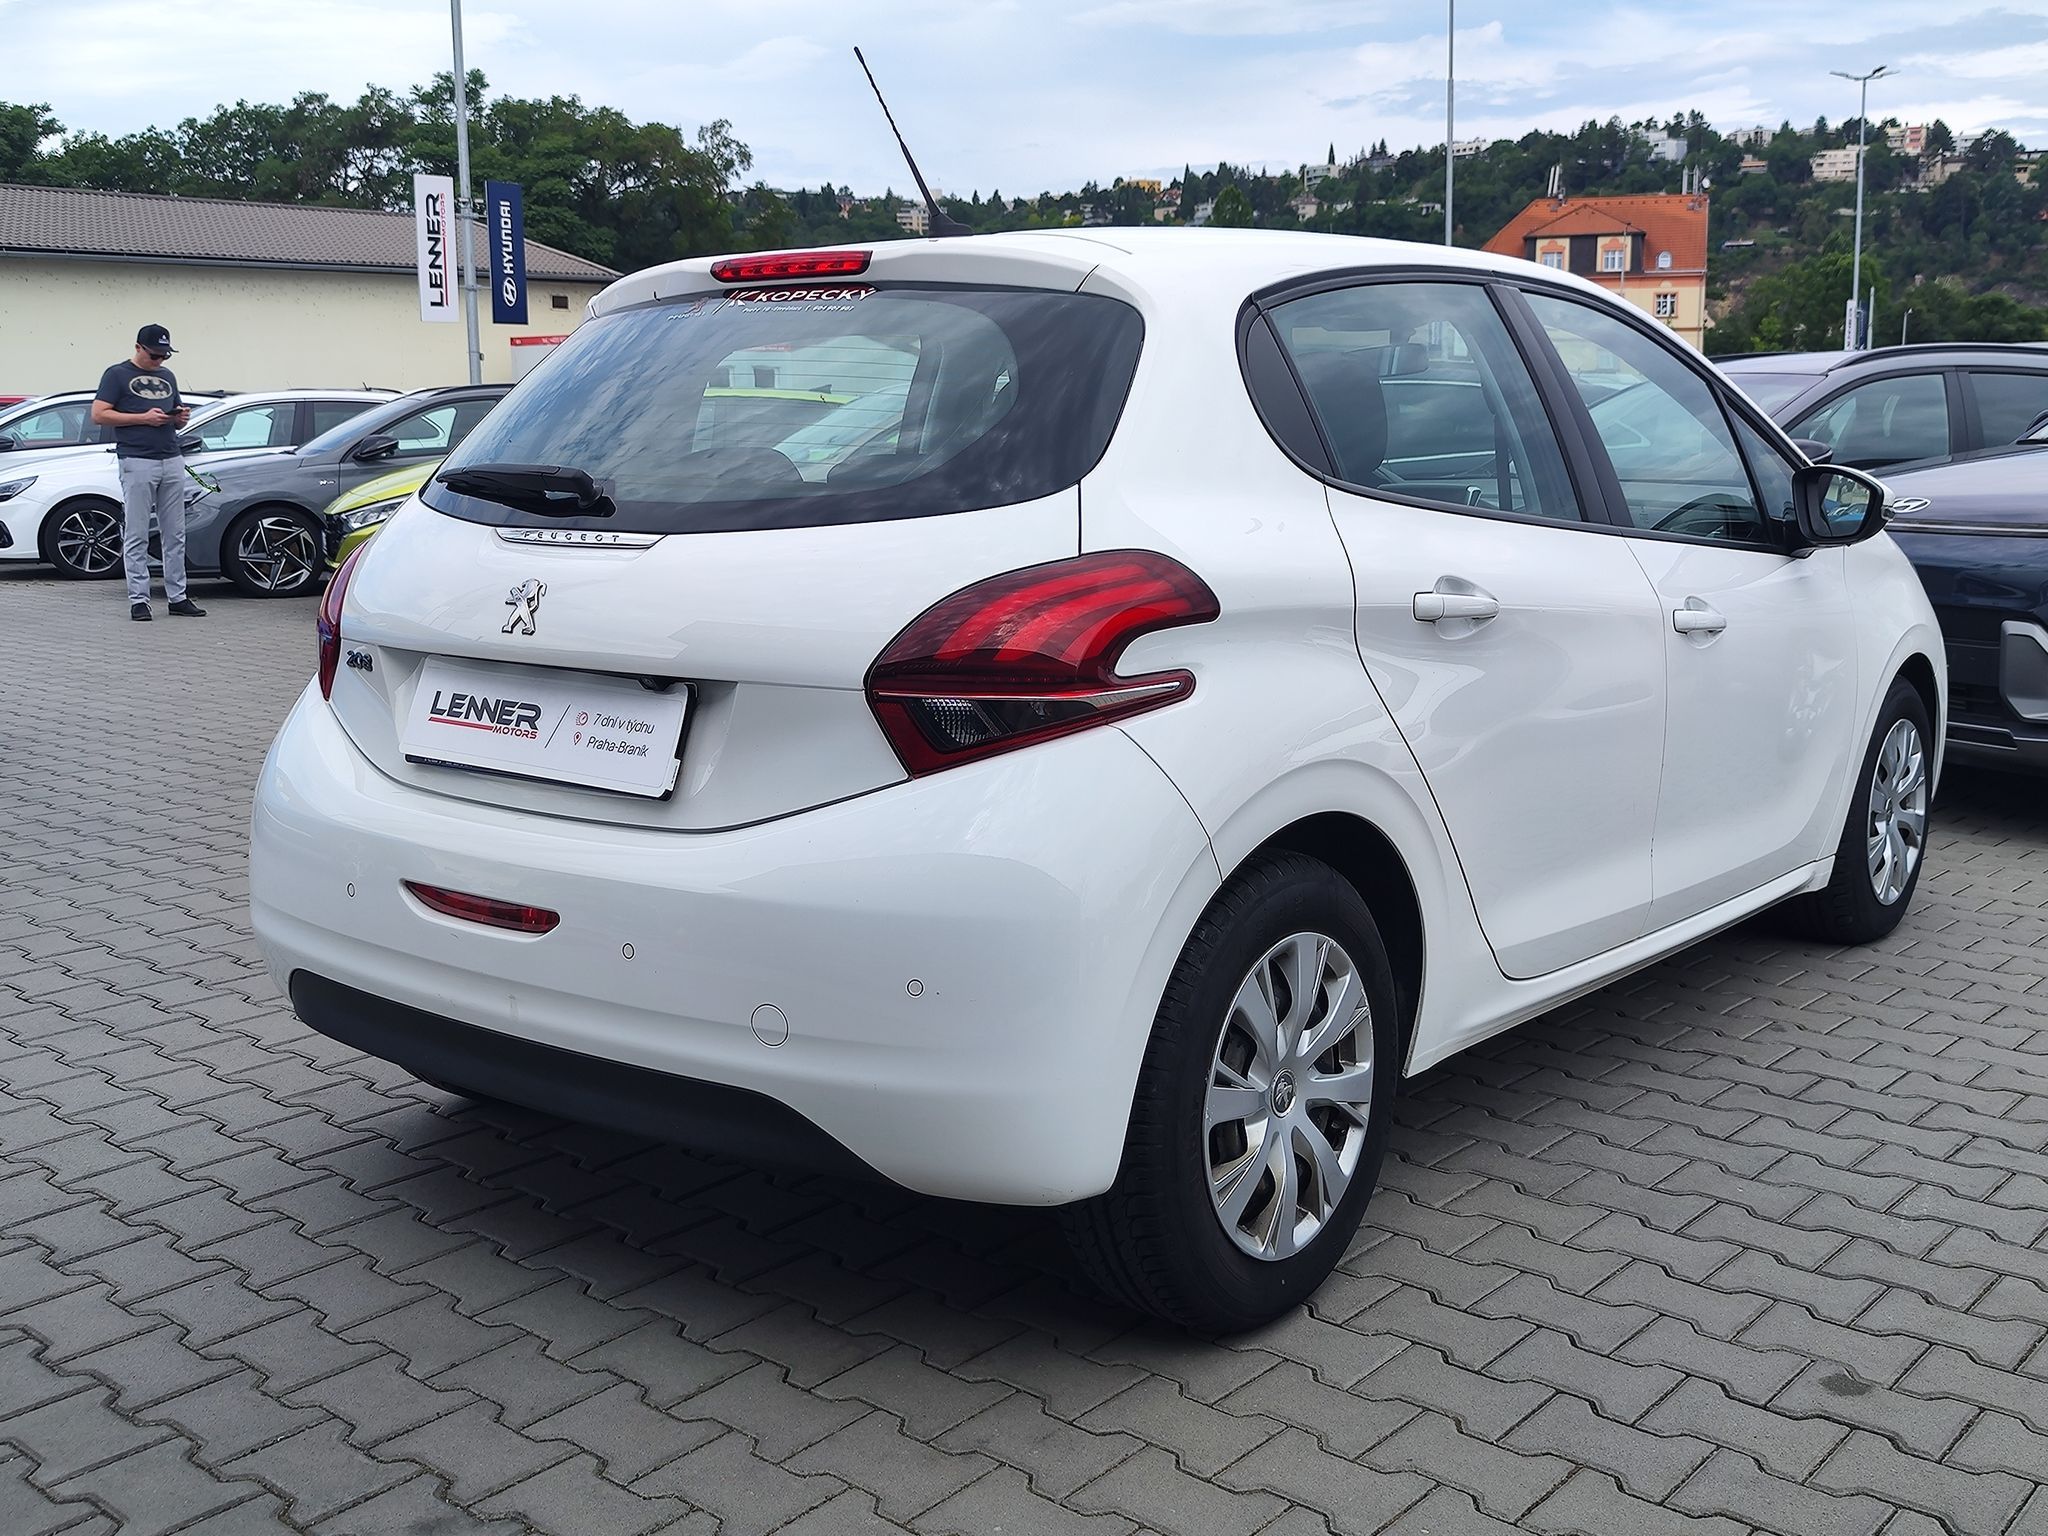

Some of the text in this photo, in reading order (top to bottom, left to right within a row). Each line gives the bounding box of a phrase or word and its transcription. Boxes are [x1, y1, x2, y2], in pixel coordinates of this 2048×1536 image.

[500, 200, 515, 275] HYUNDAI
[425, 193, 445, 308] LENNER
[523, 531, 620, 543] PEUGEOT
[345, 650, 374, 672] 208
[429, 690, 542, 731] LENNER
[492, 725, 538, 740] MOTORS
[593, 713, 656, 735] 7 dní v týdnu
